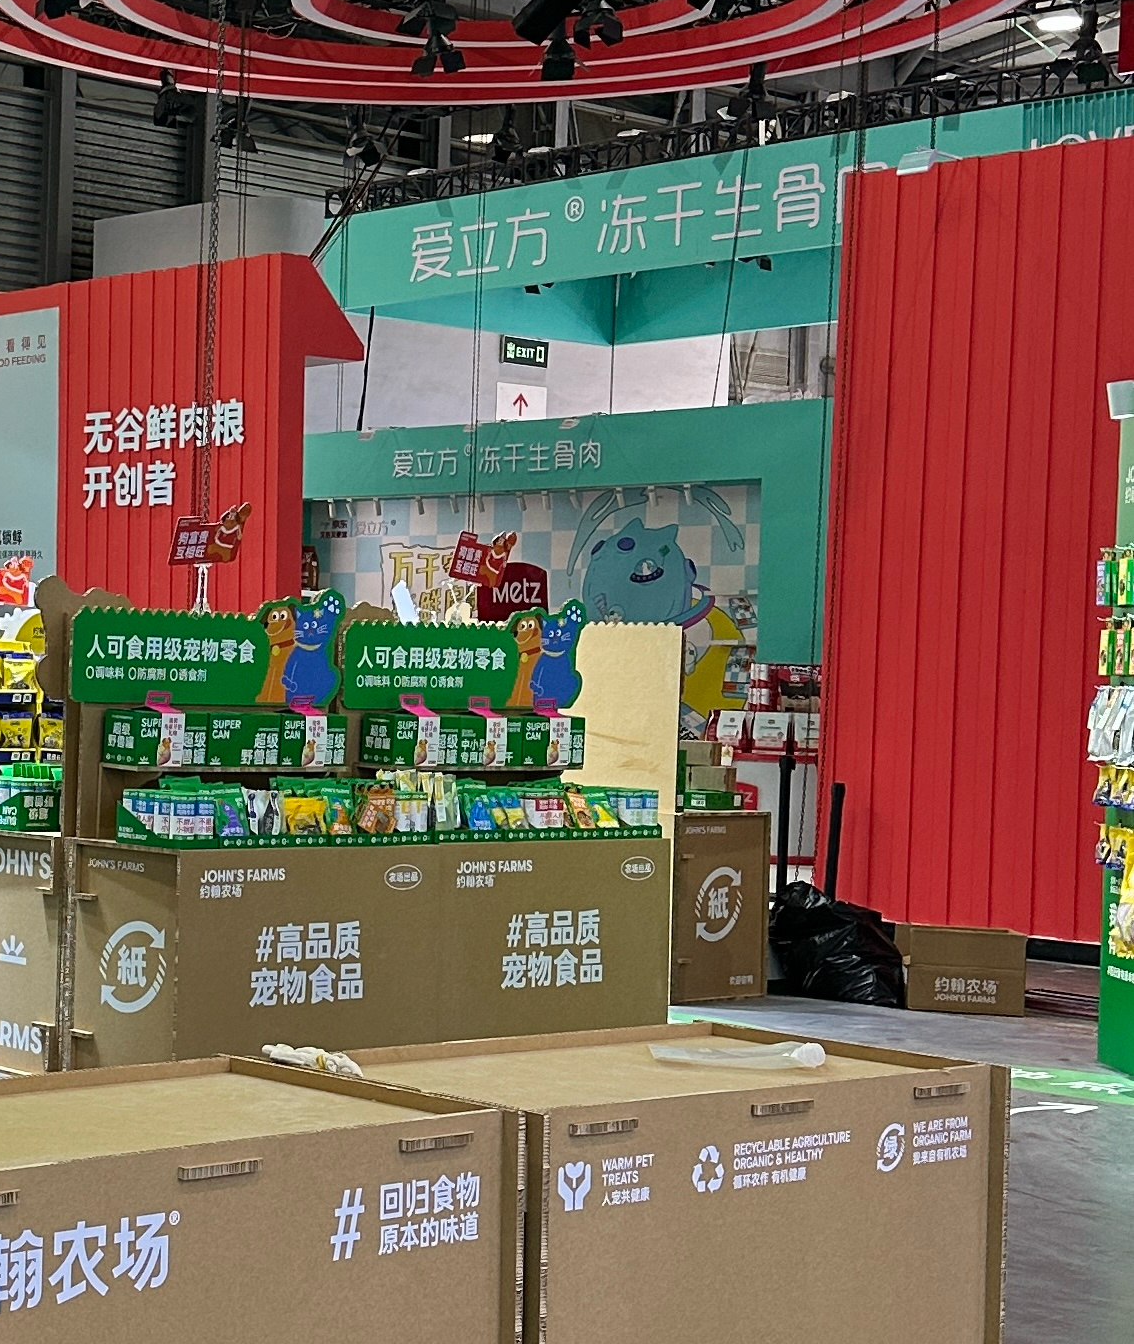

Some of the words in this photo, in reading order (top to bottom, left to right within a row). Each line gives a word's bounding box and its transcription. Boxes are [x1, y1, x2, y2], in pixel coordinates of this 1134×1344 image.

[11, 353, 46, 367] FEEDING
[516, 347, 535, 359] EXIT
[83, 398, 245, 455] 无谷鲜肉粮
[478, 438, 603, 474] 冻干生骨肉
[83, 460, 176, 510] 开创者
[492, 577, 542, 604] Metz
[86, 634, 256, 664] 人可食用级宠物零食
[356, 645, 507, 671] 人可食用级宠物零食
[141, 718, 162, 728] SUPE
[141, 728, 159, 738] CAN
[212, 719, 242, 730] SUPER
[397, 721, 417, 731] SUPE
[212, 729, 230, 740] CAN
[284, 730, 301, 740] CAN
[397, 731, 413, 740] CAN
[526, 732, 541, 741] CAN
[87, 857, 116, 871] JOHN'S
[117, 859, 145, 874] FARMS
[200, 868, 245, 884] JOHN'S
[247, 867, 286, 883] FARMS
[456, 860, 496, 874] JOHN'S
[498, 859, 533, 873] FARMS
[506, 908, 601, 948] #高品质
[255, 920, 361, 963] #高品质
[117, 943, 147, 988] 紙
[500, 948, 603, 989] 宠物食品
[249, 962, 364, 1008] 宠物食品
[933, 976, 998, 997] 约翰农场
[912, 1121, 926, 1135] WE
[927, 1119, 944, 1133] ARE
[945, 1115, 969, 1131] FROM
[732, 1136, 791, 1157] RECYCLABLE
[792, 1129, 852, 1150] AGRICULTURE
[912, 1131, 948, 1149] ORGANIC
[948, 1127, 973, 1144] FARM
[601, 1156, 630, 1173] WARM
[631, 1153, 655, 1169] PET
[732, 1153, 775, 1171] ORGANIC
[775, 1152, 784, 1166] &
[784, 1147, 824, 1165] HEALTHY
[601, 1170, 640, 1186] TREATS
[378, 1170, 483, 1221] 回归食物
[377, 1210, 481, 1258] 原本的味道
